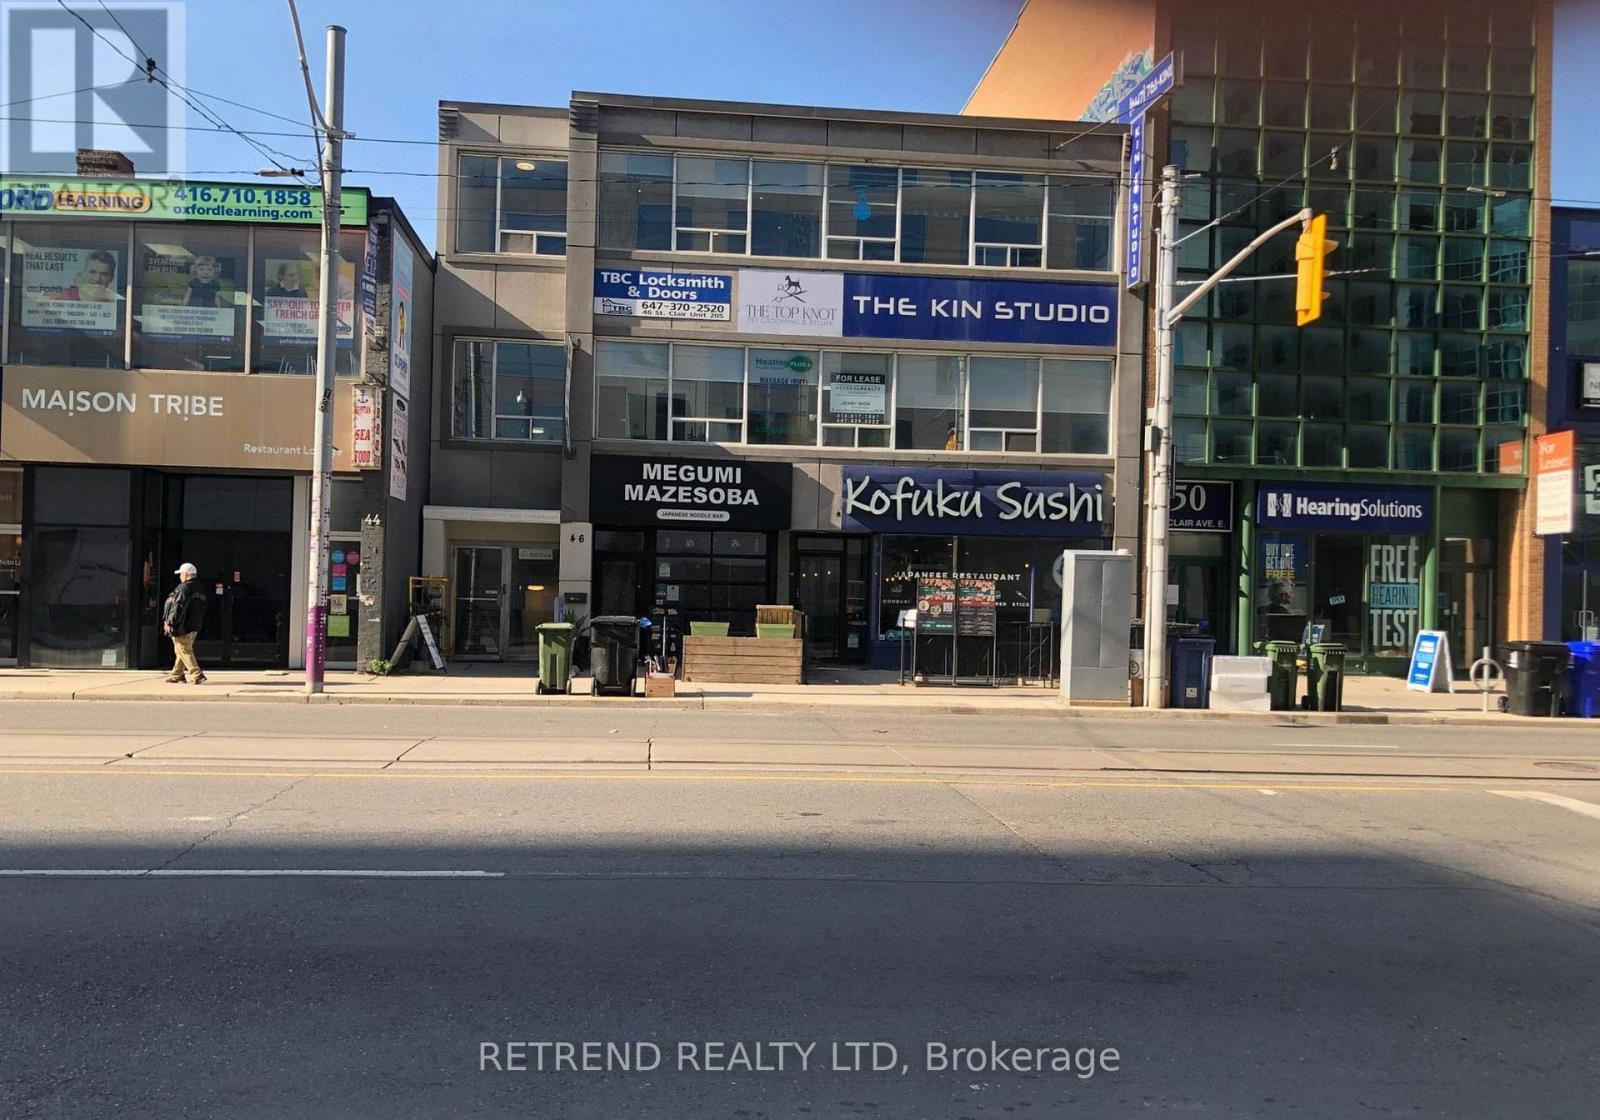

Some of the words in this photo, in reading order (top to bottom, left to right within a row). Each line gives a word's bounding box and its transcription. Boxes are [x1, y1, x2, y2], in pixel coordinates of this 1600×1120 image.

[57, 192, 145, 210] LEARNING
[173, 186, 311, 206] 416.710.1858
[173, 204, 313, 220] oxfordlearning.com
[45, 252, 78, 262] RESULTS
[25, 261, 46, 270] THAT
[46, 262, 65, 271] LAST
[600, 271, 632, 284] TBC
[639, 273, 725, 289] Locksmith
[627, 285, 640, 298] &
[648, 287, 697, 300] Doors
[275, 310, 308, 319] FRENCH
[641, 302, 725, 313] 647-370-2520
[745, 304, 769, 318] THE
[773, 305, 800, 319] TOP
[802, 307, 837, 320] KNOT
[853, 295, 917, 316] THE
[930, 298, 982, 319] KIN
[995, 301, 1110, 324] STUDIO
[21, 388, 137, 417] MAISON
[149, 393, 224, 421] TRIBE
[355, 429, 371, 441] SEA
[243, 443, 301, 455] Restaurant
[1540, 442, 1556, 455] For
[642, 463, 742, 484] MEGUMI
[624, 484, 760, 506] MAZESOBA
[845, 475, 984, 522] Kofuku
[996, 481, 1104, 522] Sushi
[1170, 485, 1206, 511] 50
[1296, 496, 1423, 521] HearingSolutions
[365, 513, 381, 525] 44
[570, 534, 585, 543] 46
[1265, 543, 1280, 556] BUY
[1281, 543, 1295, 556] ONE
[1265, 556, 1279, 569] GET
[1280, 556, 1295, 569] ONE
[1370, 544, 1419, 583] FREE
[893, 571, 948, 579] JAPANESE
[952, 572, 1021, 581] RESTAURANT
[1265, 569, 1295, 579] FREE
[1370, 609, 1418, 647] TEST
